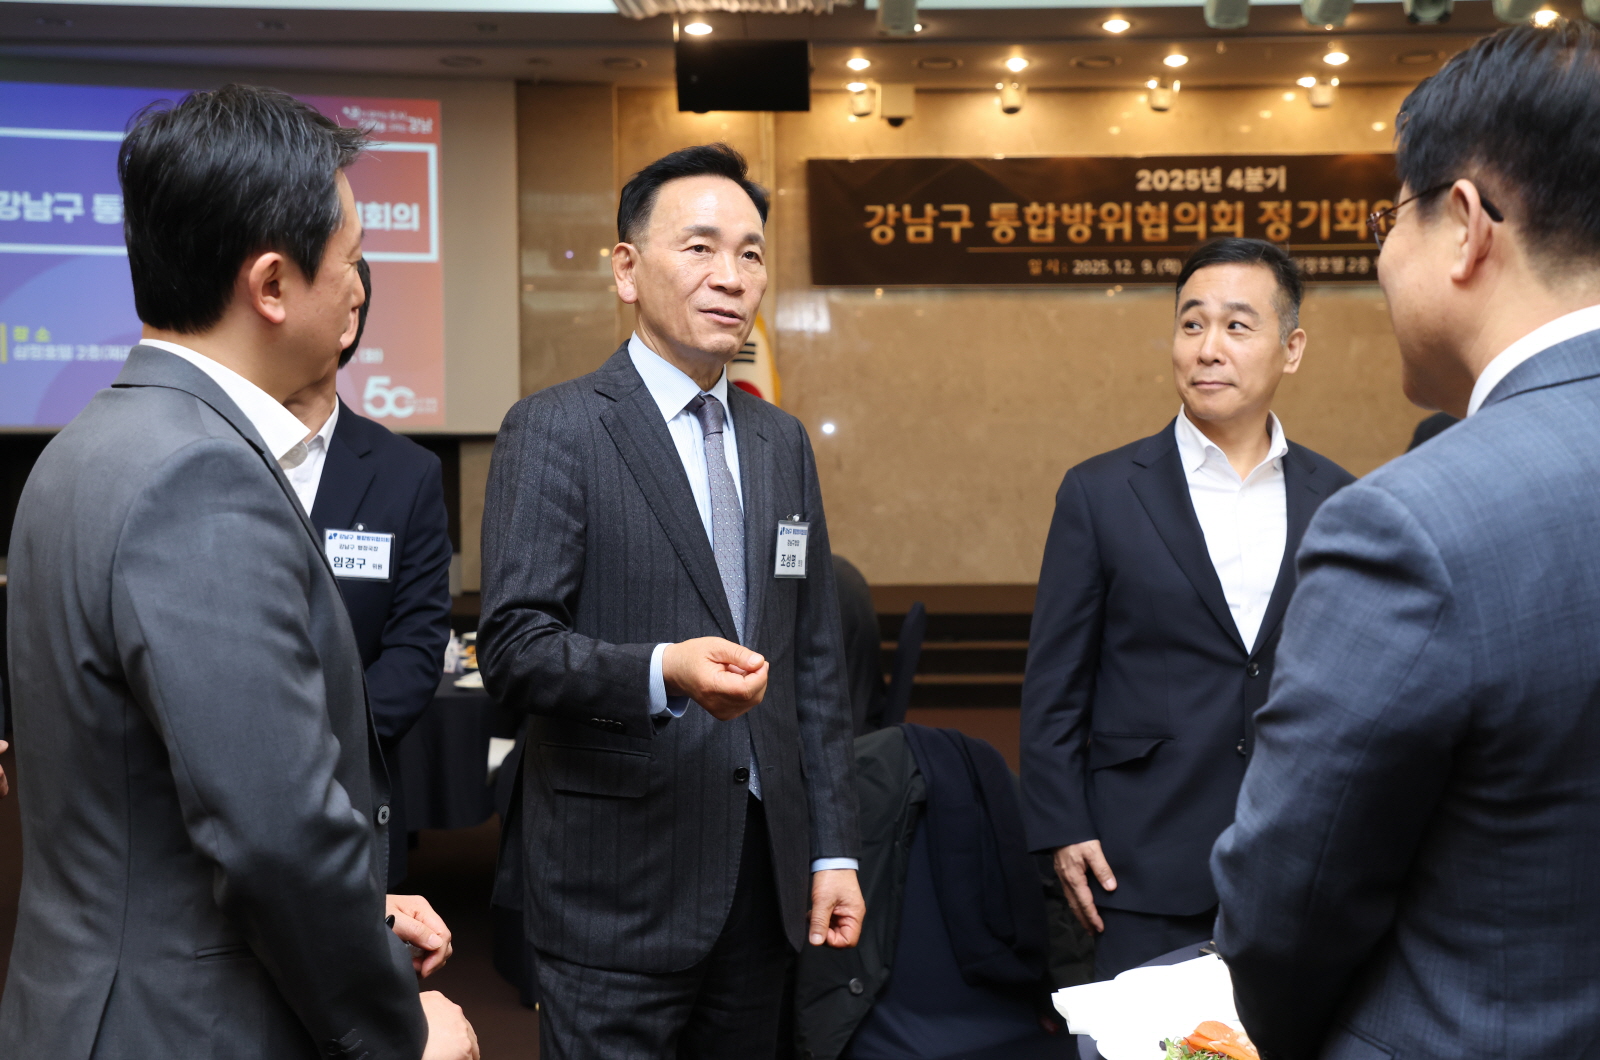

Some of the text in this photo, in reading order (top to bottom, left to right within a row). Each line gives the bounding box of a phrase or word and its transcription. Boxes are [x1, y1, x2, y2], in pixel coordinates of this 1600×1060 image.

[1136, 165, 1287, 193] 2025년 4분기
[0, 190, 85, 224] 강남구
[863, 203, 974, 245] 강남구
[986, 201, 1245, 243] 통합방위협의회
[333, 556, 366, 569] 임경구
